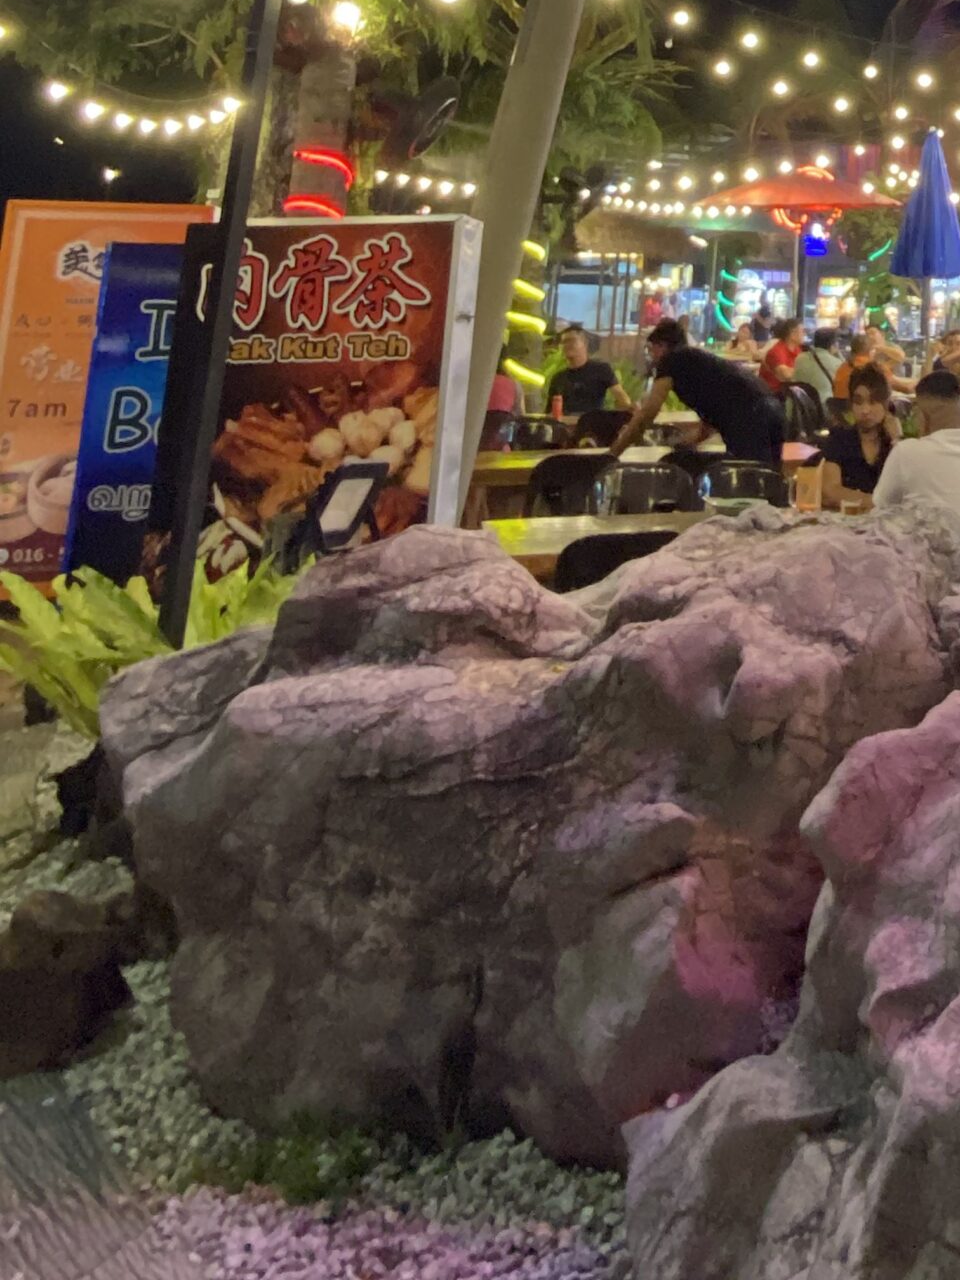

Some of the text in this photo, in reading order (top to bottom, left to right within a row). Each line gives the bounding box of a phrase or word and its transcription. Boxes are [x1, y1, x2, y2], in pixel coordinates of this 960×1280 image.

[227, 331, 411, 363] ak Kut Teh
[8, 398, 68, 418] 7am
